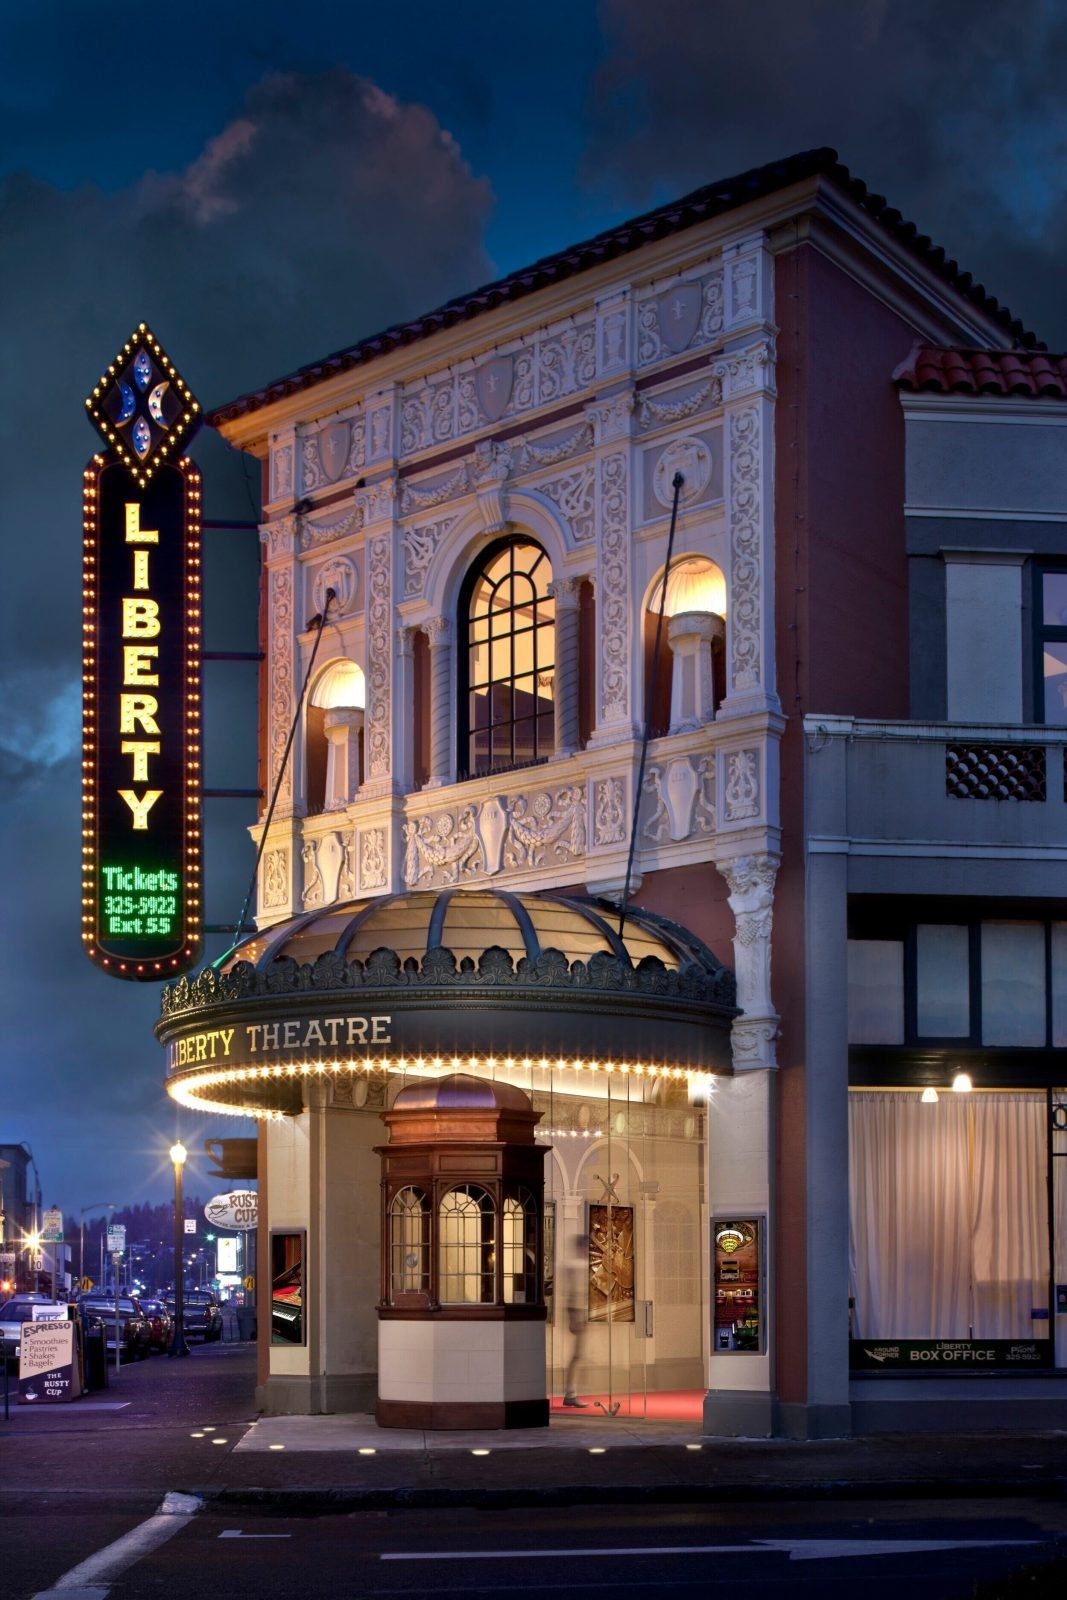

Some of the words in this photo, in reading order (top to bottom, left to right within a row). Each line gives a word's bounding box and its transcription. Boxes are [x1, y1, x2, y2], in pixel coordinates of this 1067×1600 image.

[117, 503, 164, 830] LIBERTY
[102, 866, 178, 891] Tickets
[110, 916, 143, 934] Ext
[145, 917, 171, 934] 55
[170, 1028, 235, 1069] LIBERTY
[246, 1016, 392, 1052] THEATRE
[229, 1194, 259, 1208] RUST
[234, 1208, 258, 1223] CUP
[23, 1322, 71, 1338] ESPRESSO
[29, 1337, 69, 1346] Smoothies
[29, 1345, 58, 1353] Pastries
[29, 1352, 56, 1360] Shakes
[909, 1350, 940, 1361] BOX
[942, 1350, 996, 1361] OFFICE
[28, 1360, 54, 1368] Bagels
[44, 1380, 70, 1388] RUSTY
[46, 1388, 62, 1396] CUP
